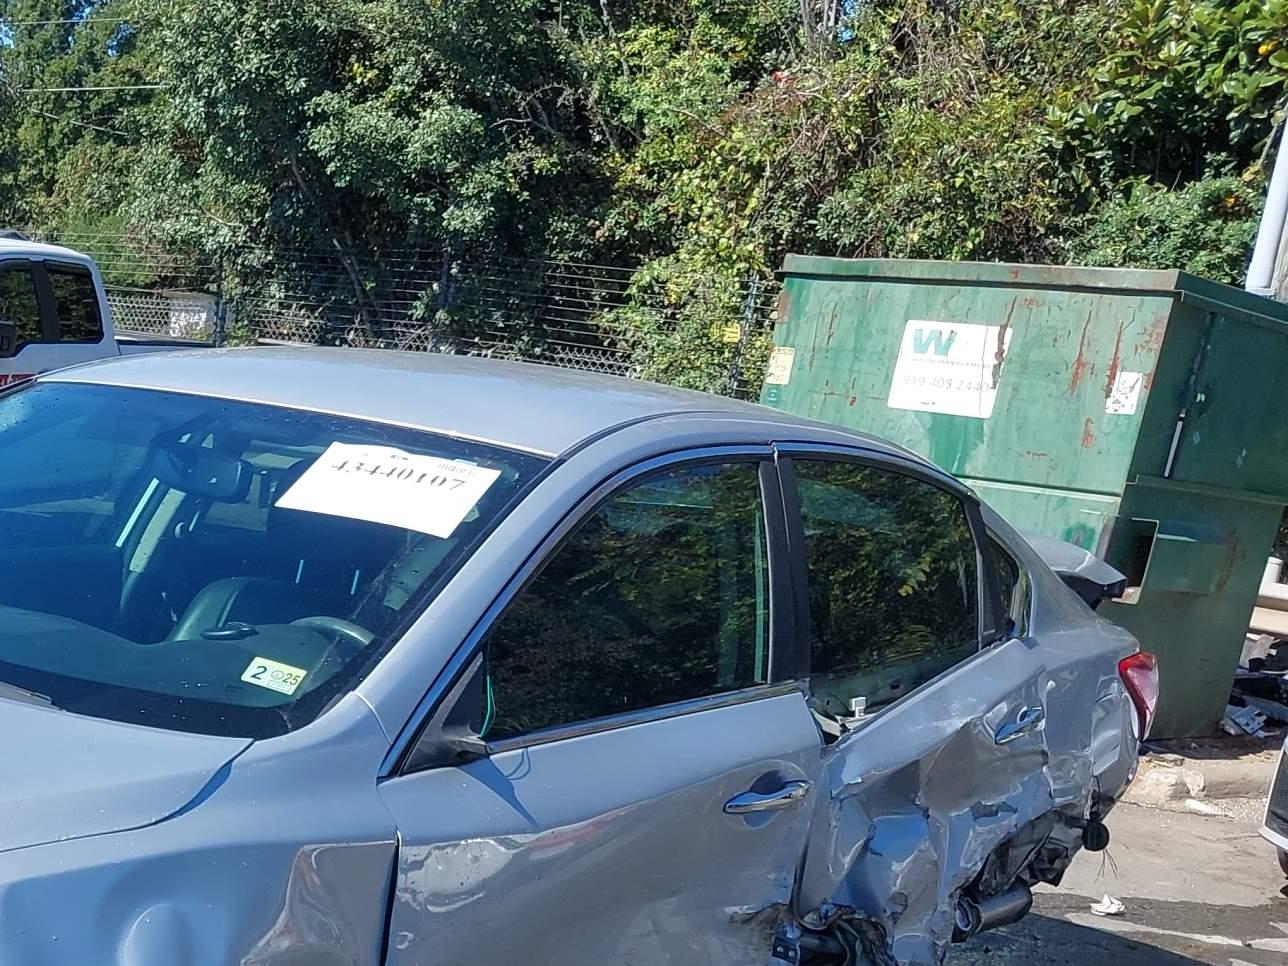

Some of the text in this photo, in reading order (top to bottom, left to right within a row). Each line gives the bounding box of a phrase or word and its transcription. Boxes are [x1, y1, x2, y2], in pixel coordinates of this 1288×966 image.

[331, 459, 467, 492] 43440107
[250, 665, 301, 686] 2 25
